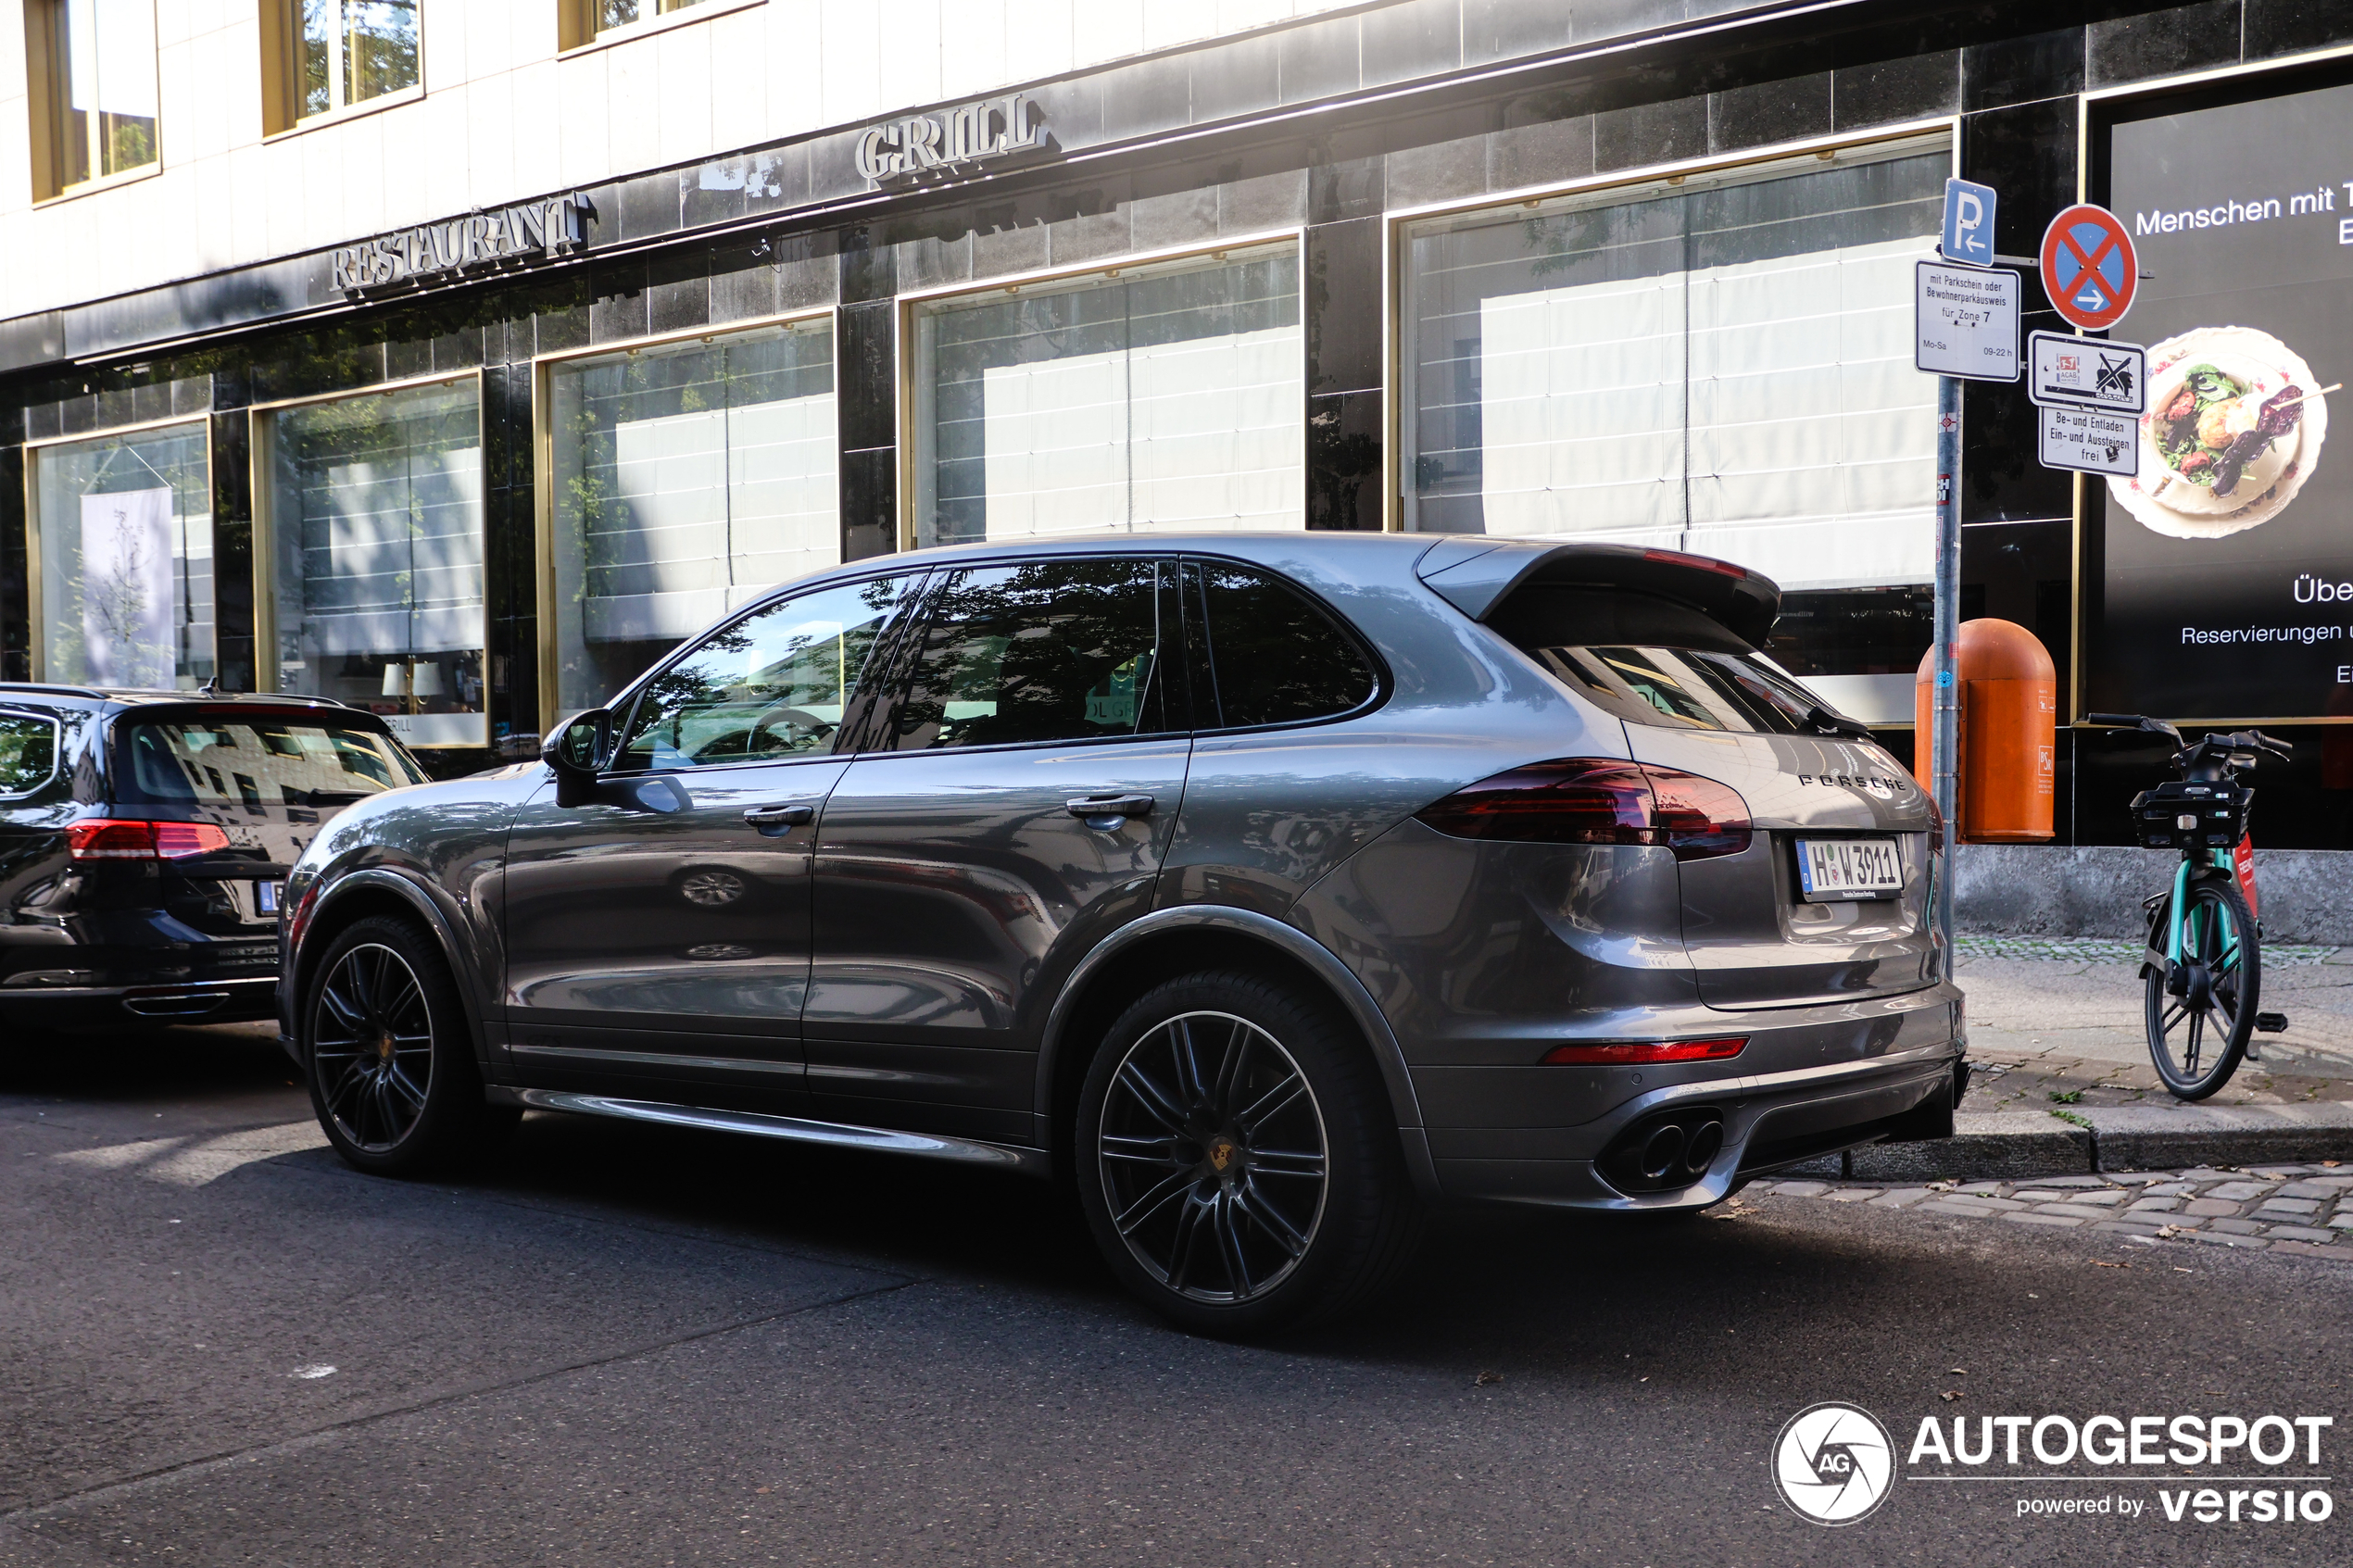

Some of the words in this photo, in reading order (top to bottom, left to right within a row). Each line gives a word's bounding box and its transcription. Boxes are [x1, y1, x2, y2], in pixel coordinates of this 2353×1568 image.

[855, 94, 1046, 181] GRILL
[1954, 191, 1983, 250] P
[2136, 198, 2281, 235] Menschen
[2290, 185, 2334, 216] mit
[329, 190, 587, 292] RESTAURANT
[1930, 273, 1942, 284] mit
[1944, 275, 1982, 290] Parkschein
[1984, 281, 2002, 292] oder
[1927, 286, 2007, 307] Bewohnerparkausweis
[1942, 307, 1955, 318] für
[1958, 308, 1980, 321] Zone
[1983, 310, 1991, 323] 7
[1923, 339, 1946, 350] Mo-Sa
[1983, 346, 2006, 357] 09-22
[2007, 348, 2013, 358] h
[2056, 411, 2070, 424] Be-
[2073, 416, 2087, 427] und
[2091, 417, 2124, 433] Entladen
[2050, 427, 2068, 440] Ein-
[2070, 432, 2083, 444] und
[2087, 433, 2130, 451] Aussteigen
[2082, 448, 2099, 462] frei
[2294, 573, 2353, 603] Übe
[2182, 624, 2342, 645] Reservierungen
[1798, 774, 1906, 791] PORSCHE
[1811, 846, 1830, 886] H
